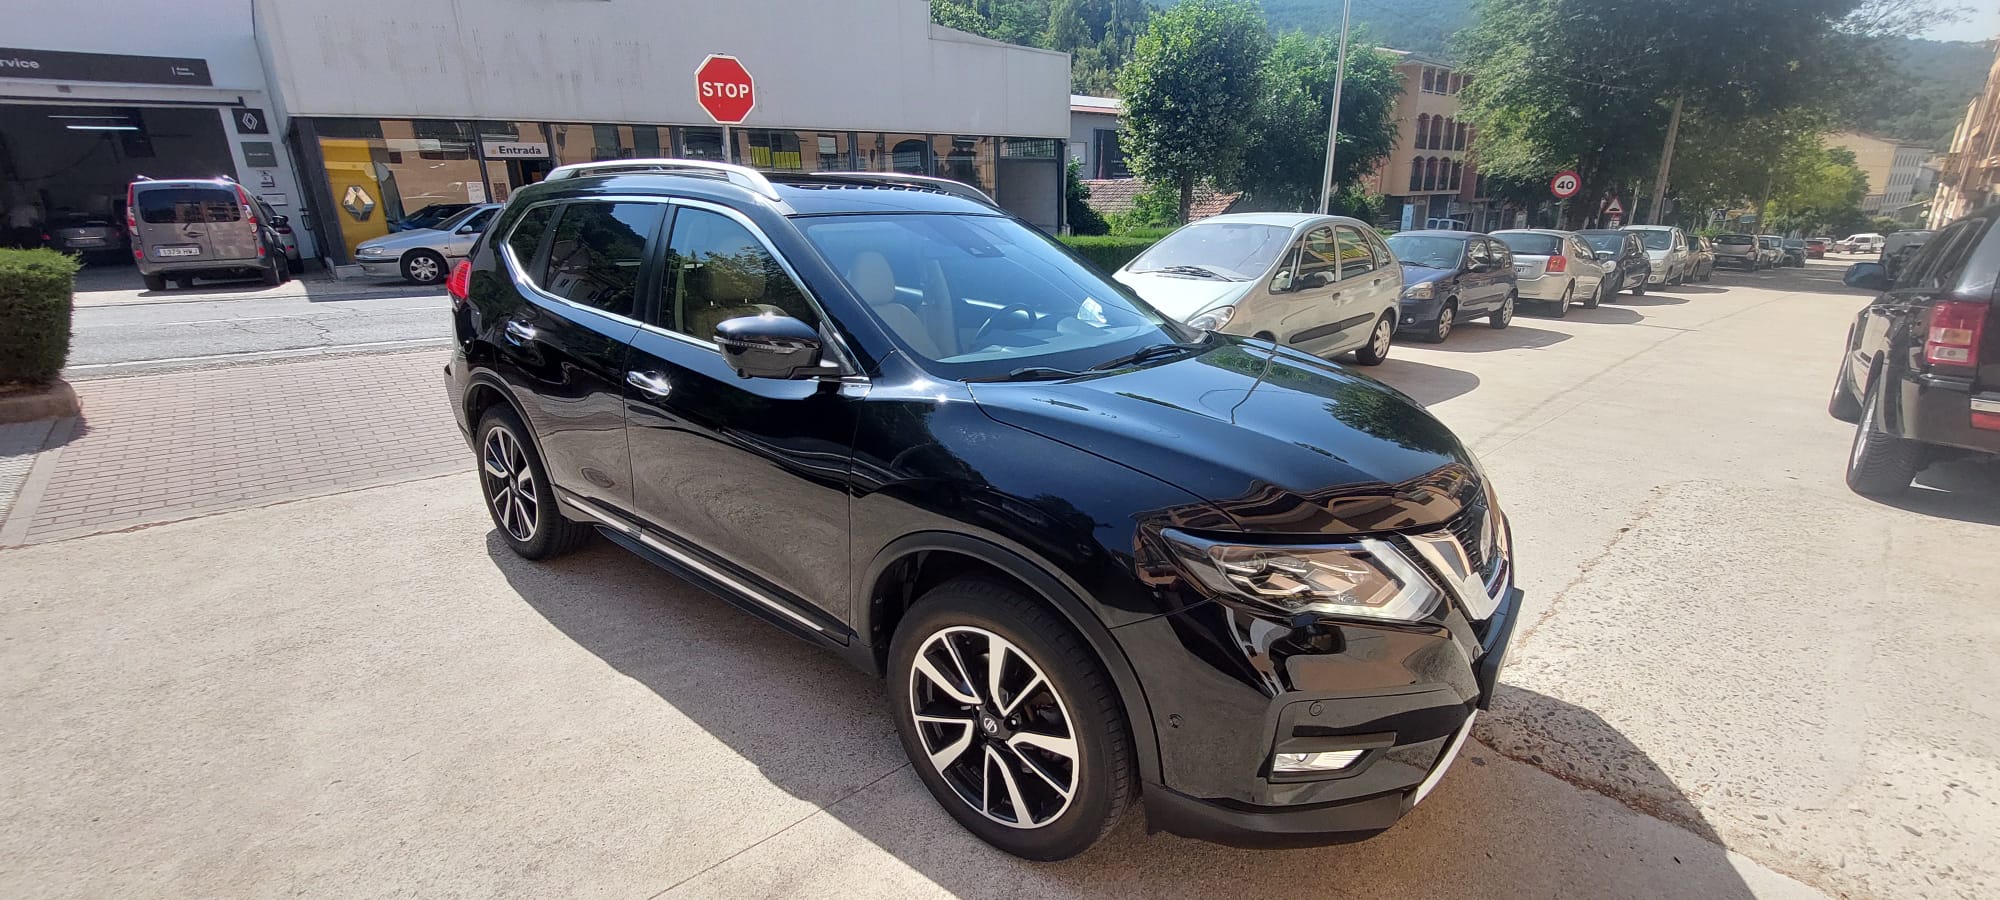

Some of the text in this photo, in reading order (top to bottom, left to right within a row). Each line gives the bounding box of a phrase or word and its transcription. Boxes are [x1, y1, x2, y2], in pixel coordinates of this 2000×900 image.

[702, 81, 750, 99] STOP
[498, 145, 542, 155] Entrada
[1557, 180, 1575, 190] 40
